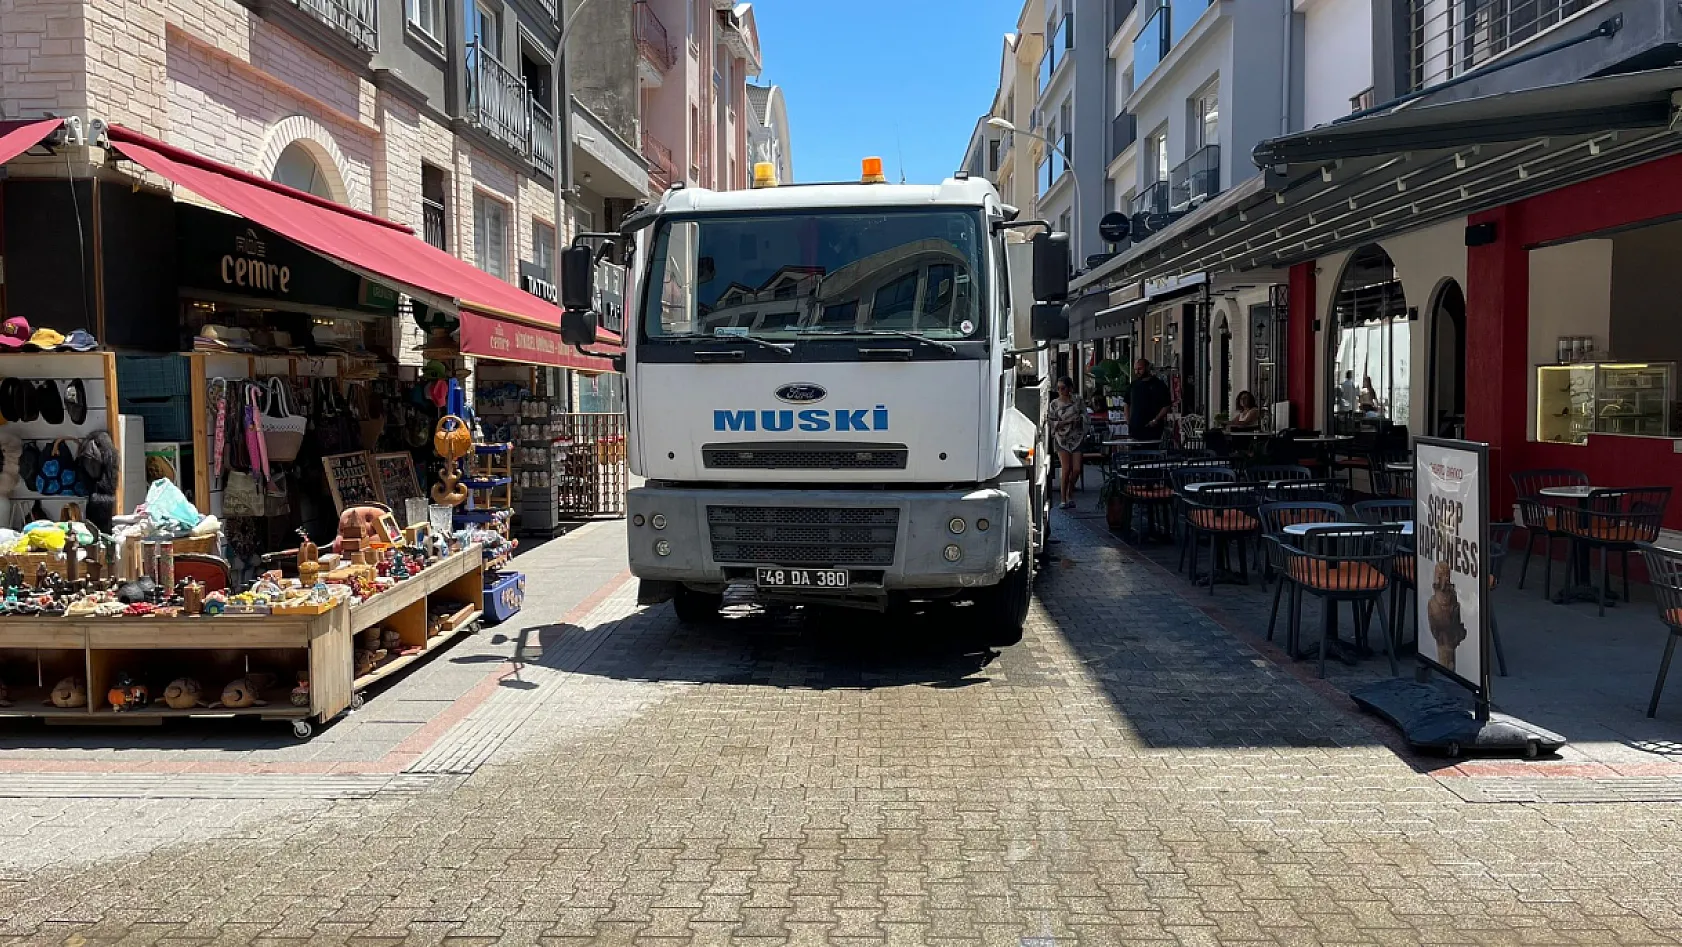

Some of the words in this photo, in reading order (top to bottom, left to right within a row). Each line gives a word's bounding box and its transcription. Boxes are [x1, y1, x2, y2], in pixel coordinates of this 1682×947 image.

[221, 255, 290, 293] cemre
[713, 404, 889, 432] MUSKİ
[1419, 522, 1478, 578] HAPPINESS
[766, 570, 785, 585] 48
[791, 571, 810, 585] DA
[817, 571, 845, 586] 380
